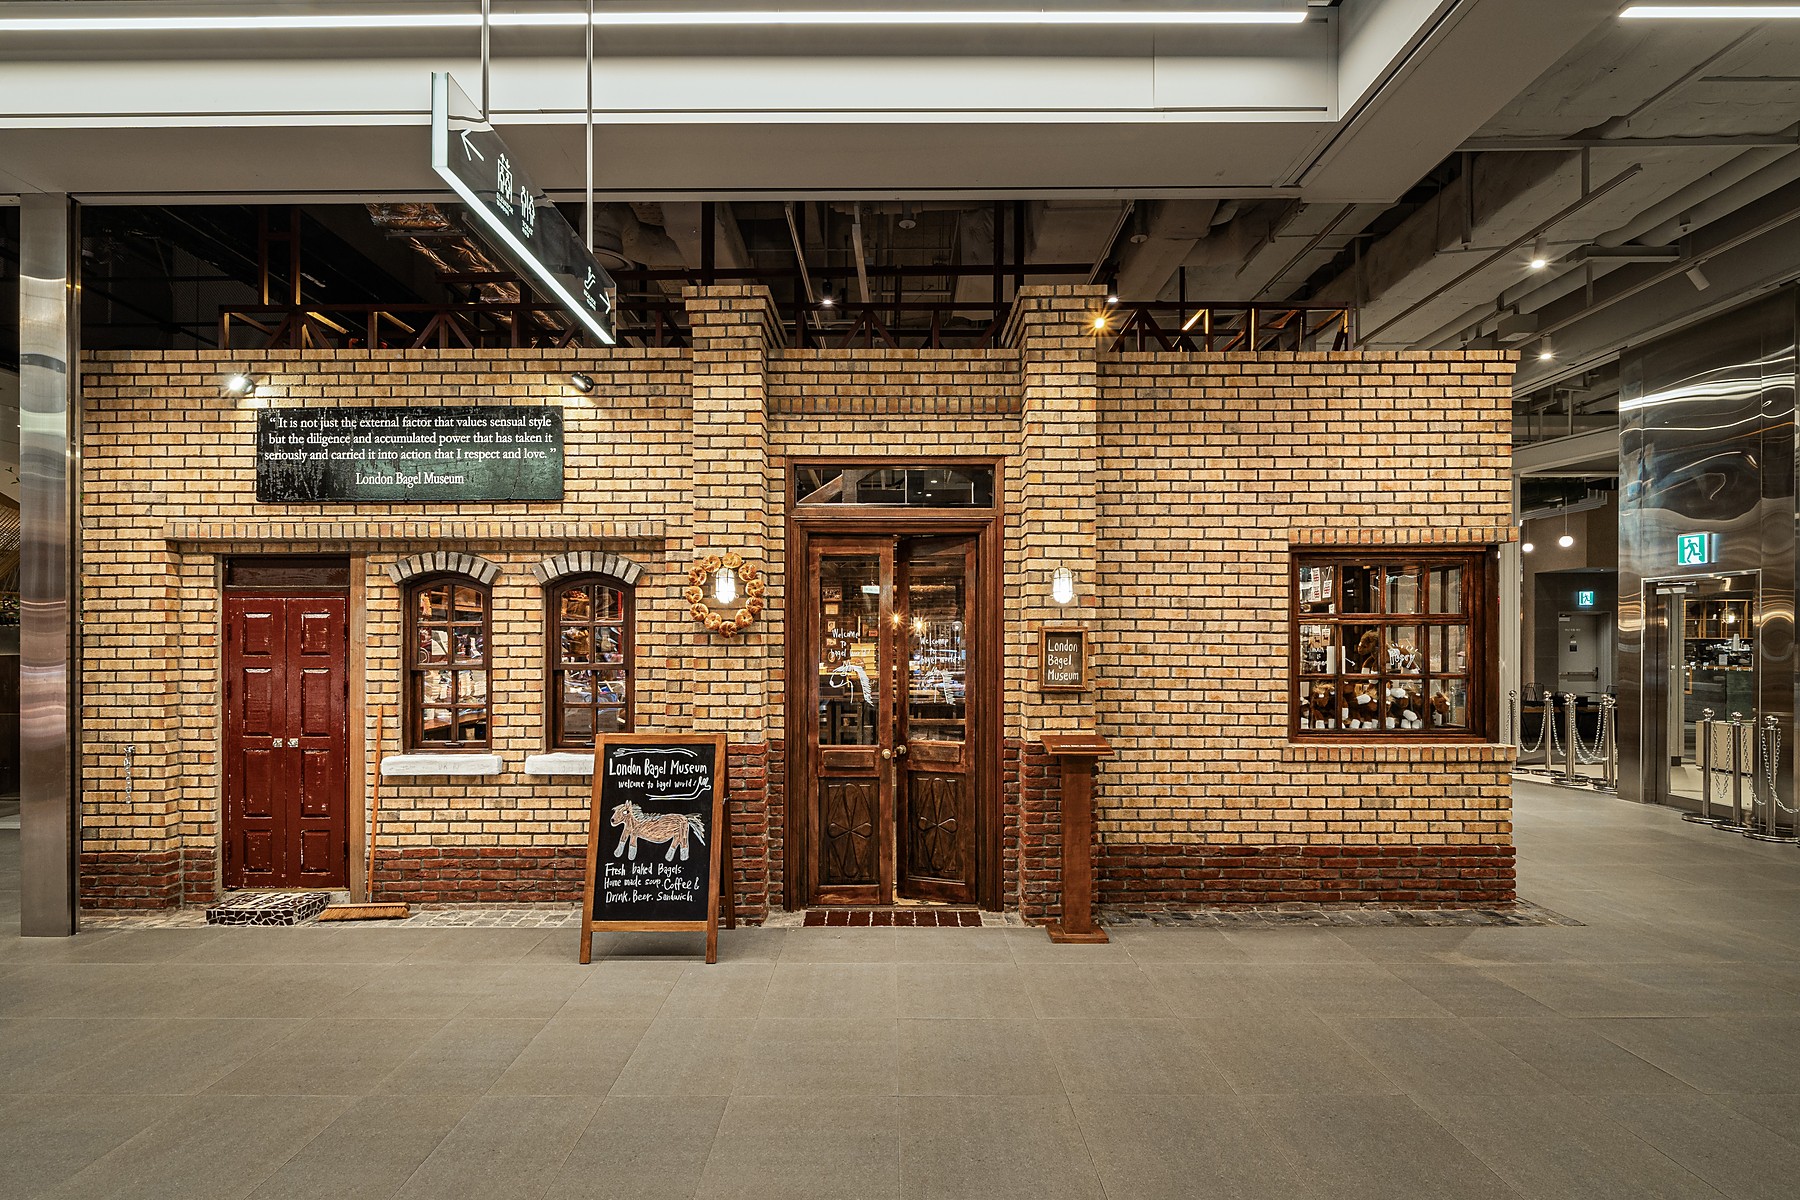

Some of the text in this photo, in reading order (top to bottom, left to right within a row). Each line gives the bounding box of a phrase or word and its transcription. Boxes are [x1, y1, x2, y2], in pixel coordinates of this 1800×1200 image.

[290, 417, 298, 428] is
[300, 420, 319, 428] not
[320, 417, 339, 430] just
[341, 417, 357, 428] the
[360, 416, 400, 428] external
[402, 416, 432, 428] factor
[434, 416, 454, 427] that
[457, 416, 487, 427] values
[490, 416, 526, 427] sensual
[529, 416, 552, 429] style
[268, 432, 553, 447] but the diligence and accumulated power that has taken it
[264, 449, 308, 463] seriously
[309, 449, 328, 460] and
[331, 449, 365, 460] carried
[368, 449, 376, 460] it
[378, 449, 398, 460] into
[400, 449, 432, 460] action
[434, 448, 454, 459] that
[456, 448, 462, 459] I
[464, 450, 501, 462] respect
[502, 448, 522, 459] and
[355, 472, 465, 489] London Bagel Museum
[1047, 639, 1078, 653] London
[1047, 654, 1072, 670] Bagel
[1047, 669, 1079, 681] Museum
[609, 757, 707, 779] London Bagel Museum
[618, 779, 645, 789] welcome
[647, 780, 654, 789] to
[656, 779, 672, 792] bagel
[605, 862, 626, 877] Fresh
[632, 862, 653, 875] baked
[604, 877, 621, 889] Home
[624, 875, 642, 887] made
[663, 877, 692, 891] Coffee
